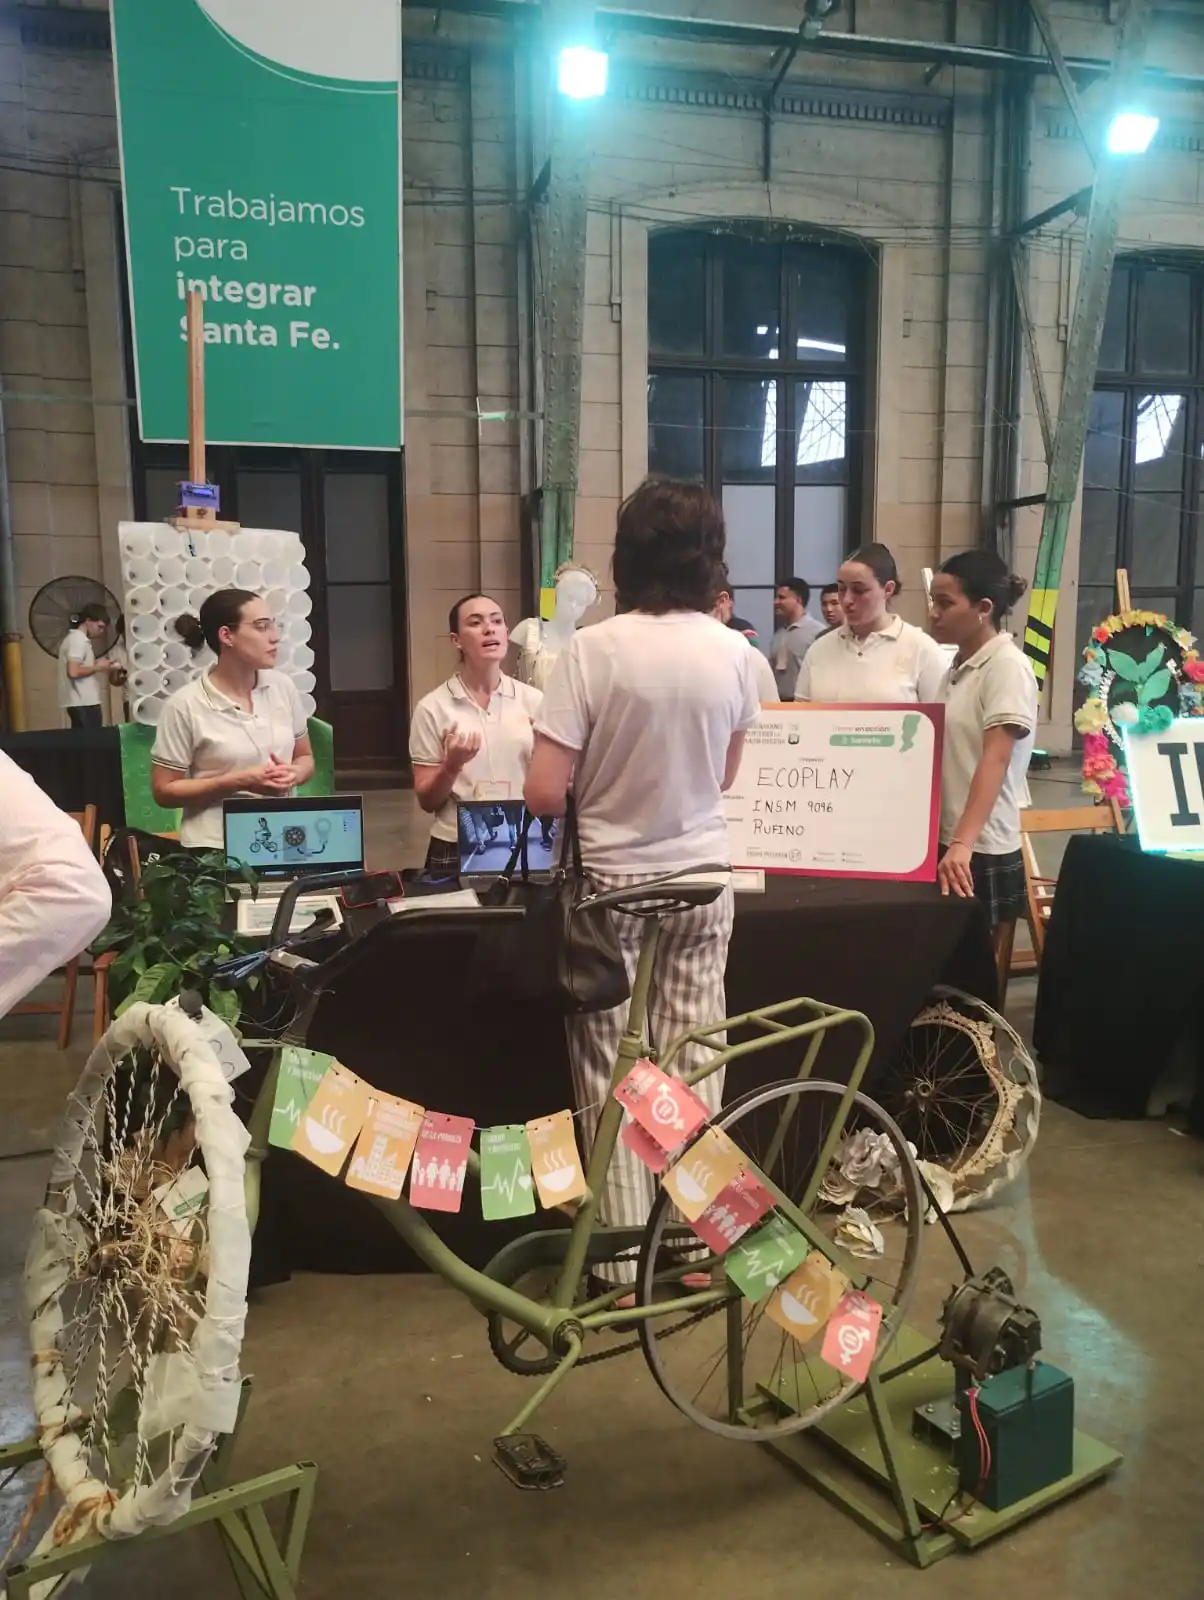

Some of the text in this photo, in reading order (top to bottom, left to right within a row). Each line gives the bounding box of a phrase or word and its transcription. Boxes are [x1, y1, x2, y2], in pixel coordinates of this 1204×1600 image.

[170, 186, 365, 227] Trabajamos
[174, 235, 248, 262] para
[176, 270, 316, 309] integrar
[290, 321, 340, 350] Fe.
[757, 766, 855, 790] ECOPLAY
[752, 799, 834, 814] INSM 9096
[752, 818, 805, 836] RUFINO
